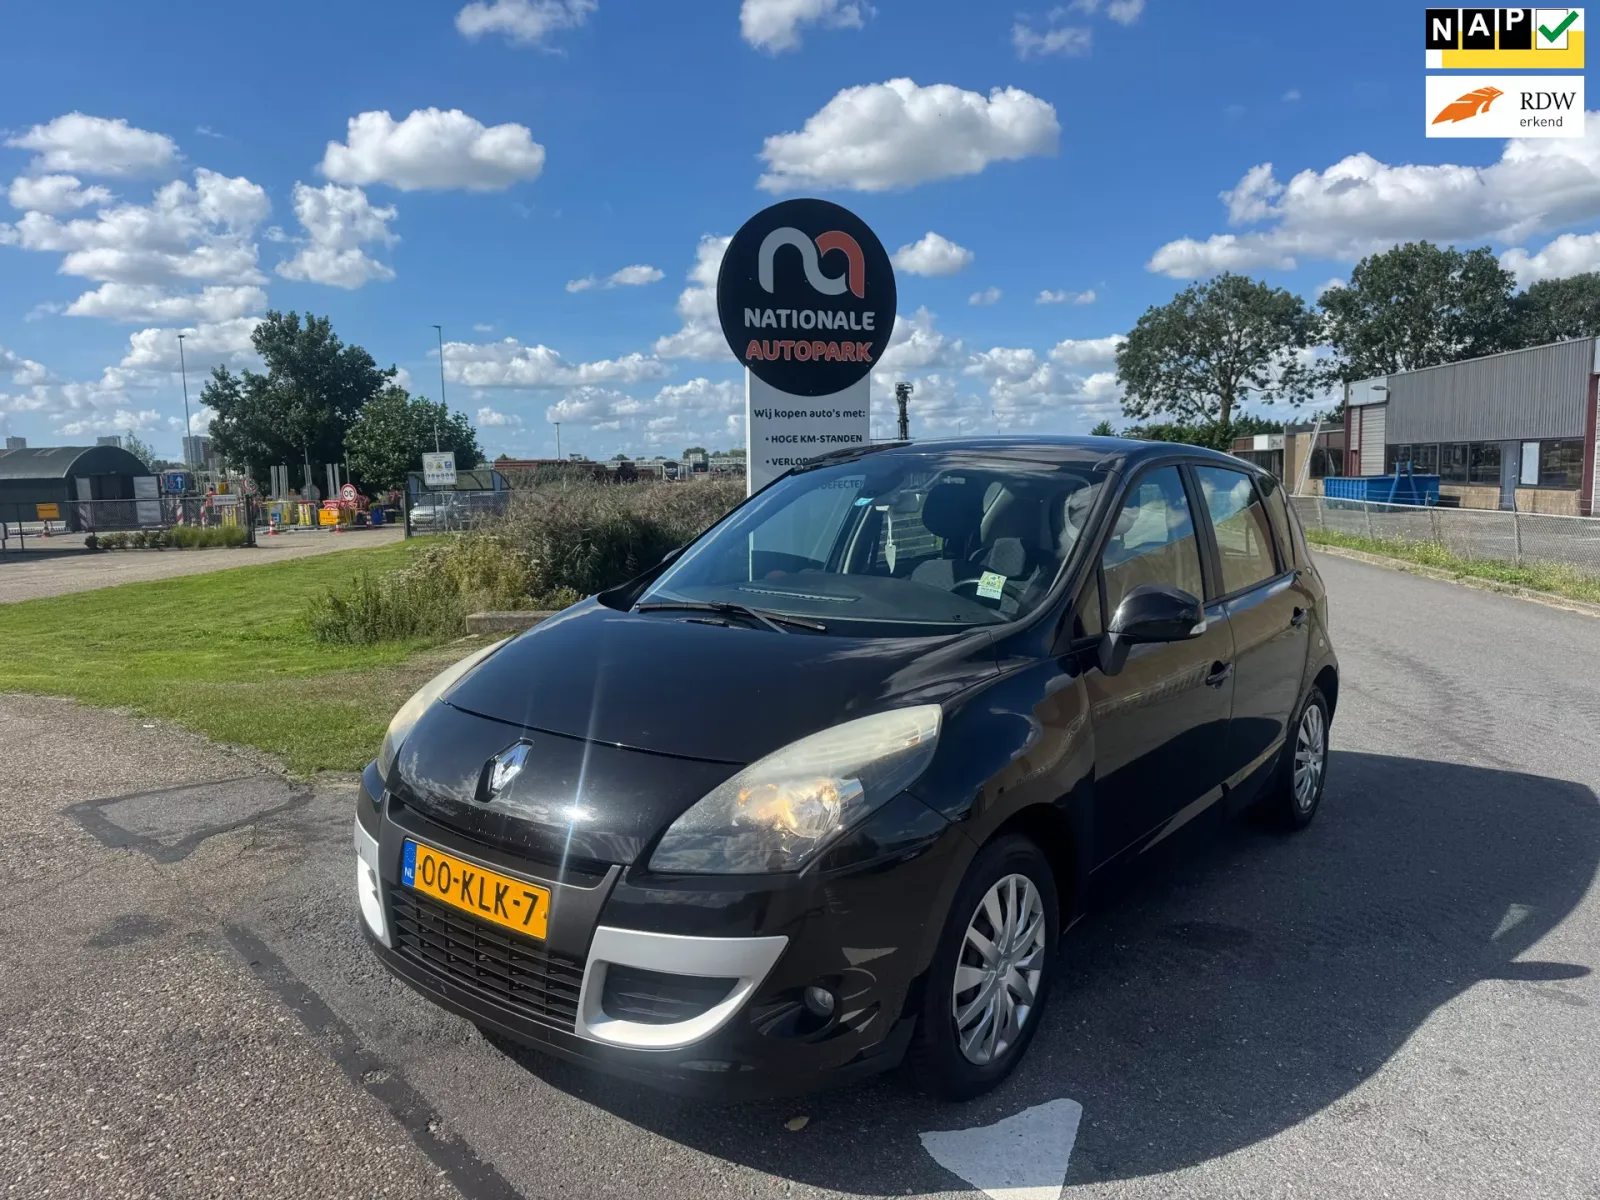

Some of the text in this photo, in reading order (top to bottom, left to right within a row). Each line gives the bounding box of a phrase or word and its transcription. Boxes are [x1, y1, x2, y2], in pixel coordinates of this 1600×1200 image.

[744, 308, 875, 331] NATIONALE
[745, 340, 873, 362] AUTOPARK
[754, 409, 866, 419] Wij kopen auto's met:
[771, 434, 863, 443] HOGE KM-STANDEN
[772, 457, 811, 466] VERLOP
[404, 867, 414, 879] NL
[422, 854, 539, 926] 00-KLK-7
